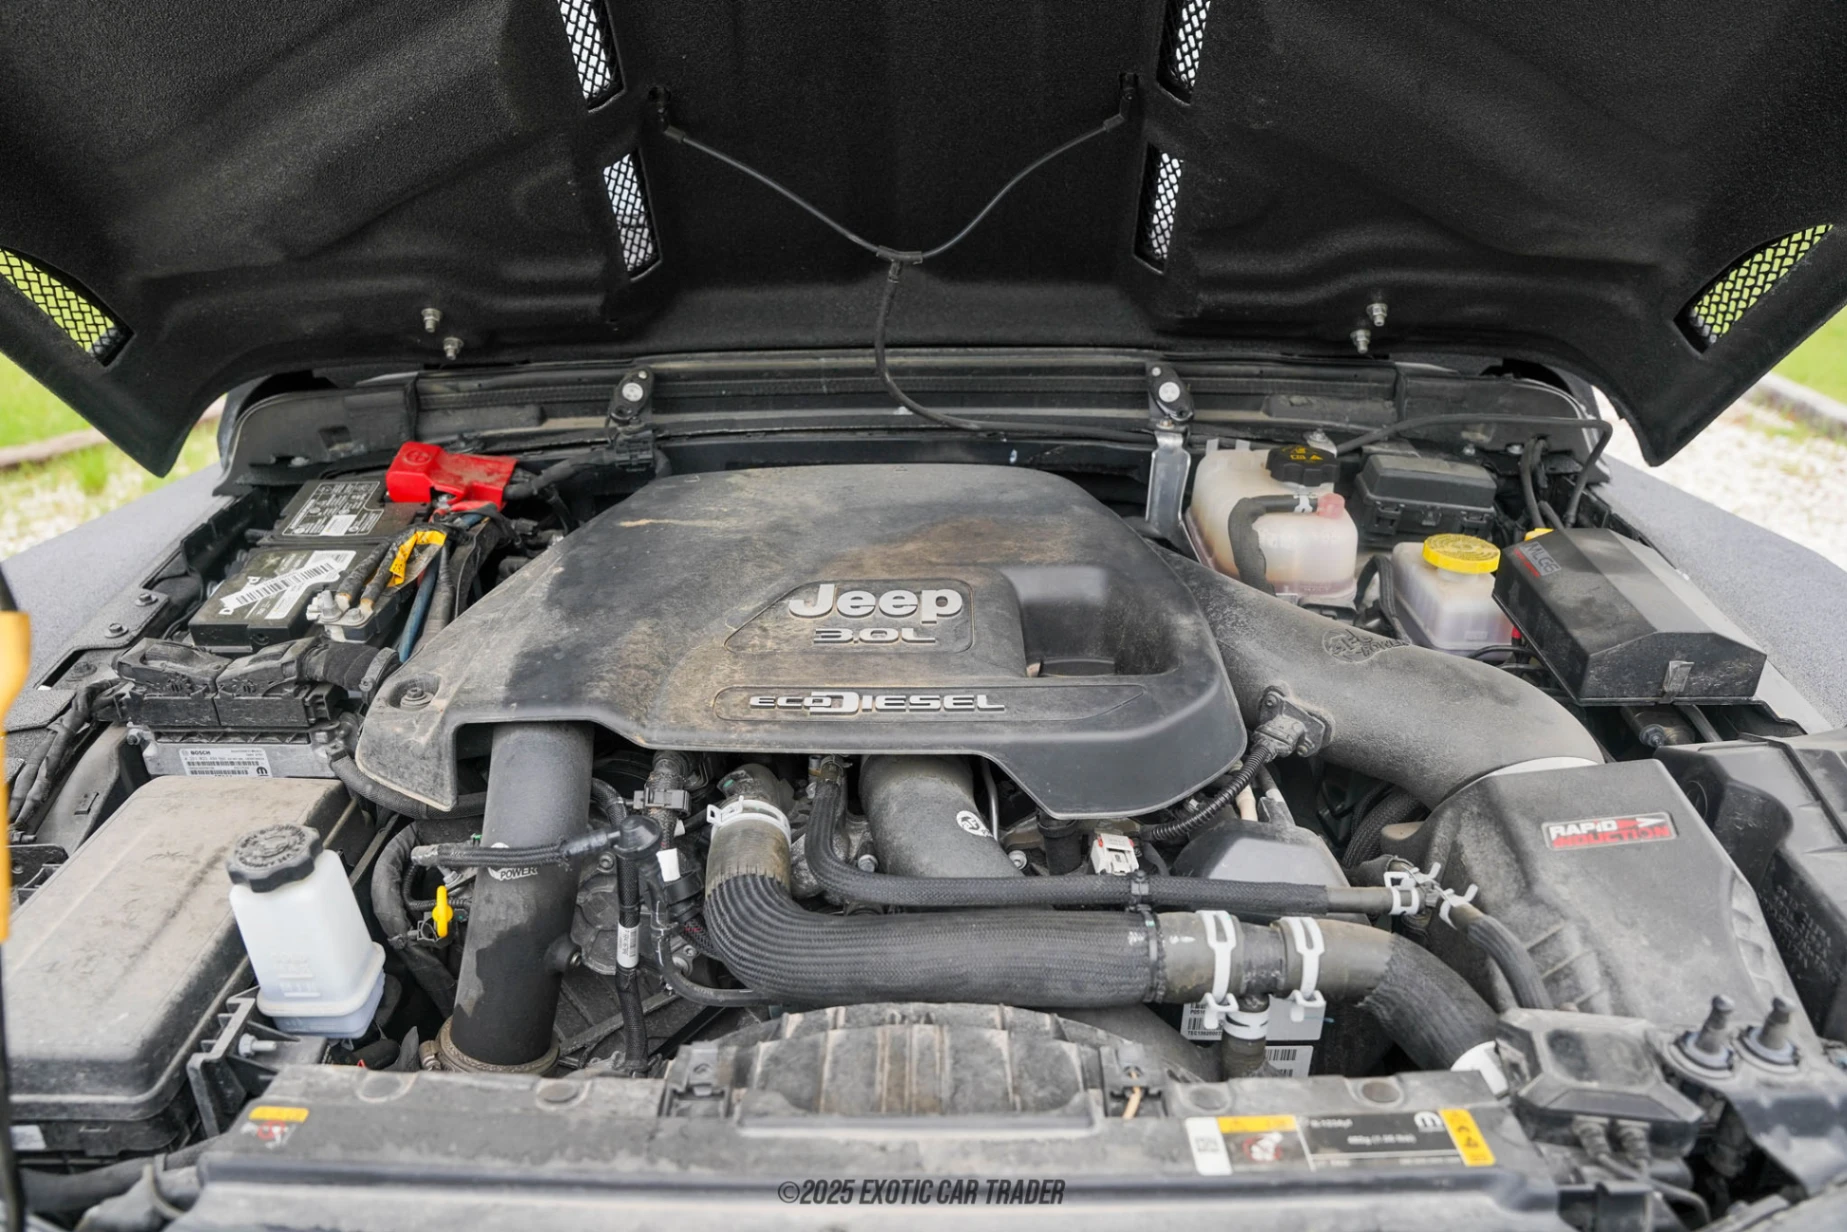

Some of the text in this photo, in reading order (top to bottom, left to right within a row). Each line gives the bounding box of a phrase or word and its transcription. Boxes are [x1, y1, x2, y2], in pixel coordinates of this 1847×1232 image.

[789, 584, 963, 624] Jeep
[813, 627, 936, 644] 3.0L
[750, 691, 1005, 715] ECODIESEL
[1552, 825, 1671, 848] INDUCTION
[500, 867, 538, 880] POWER
